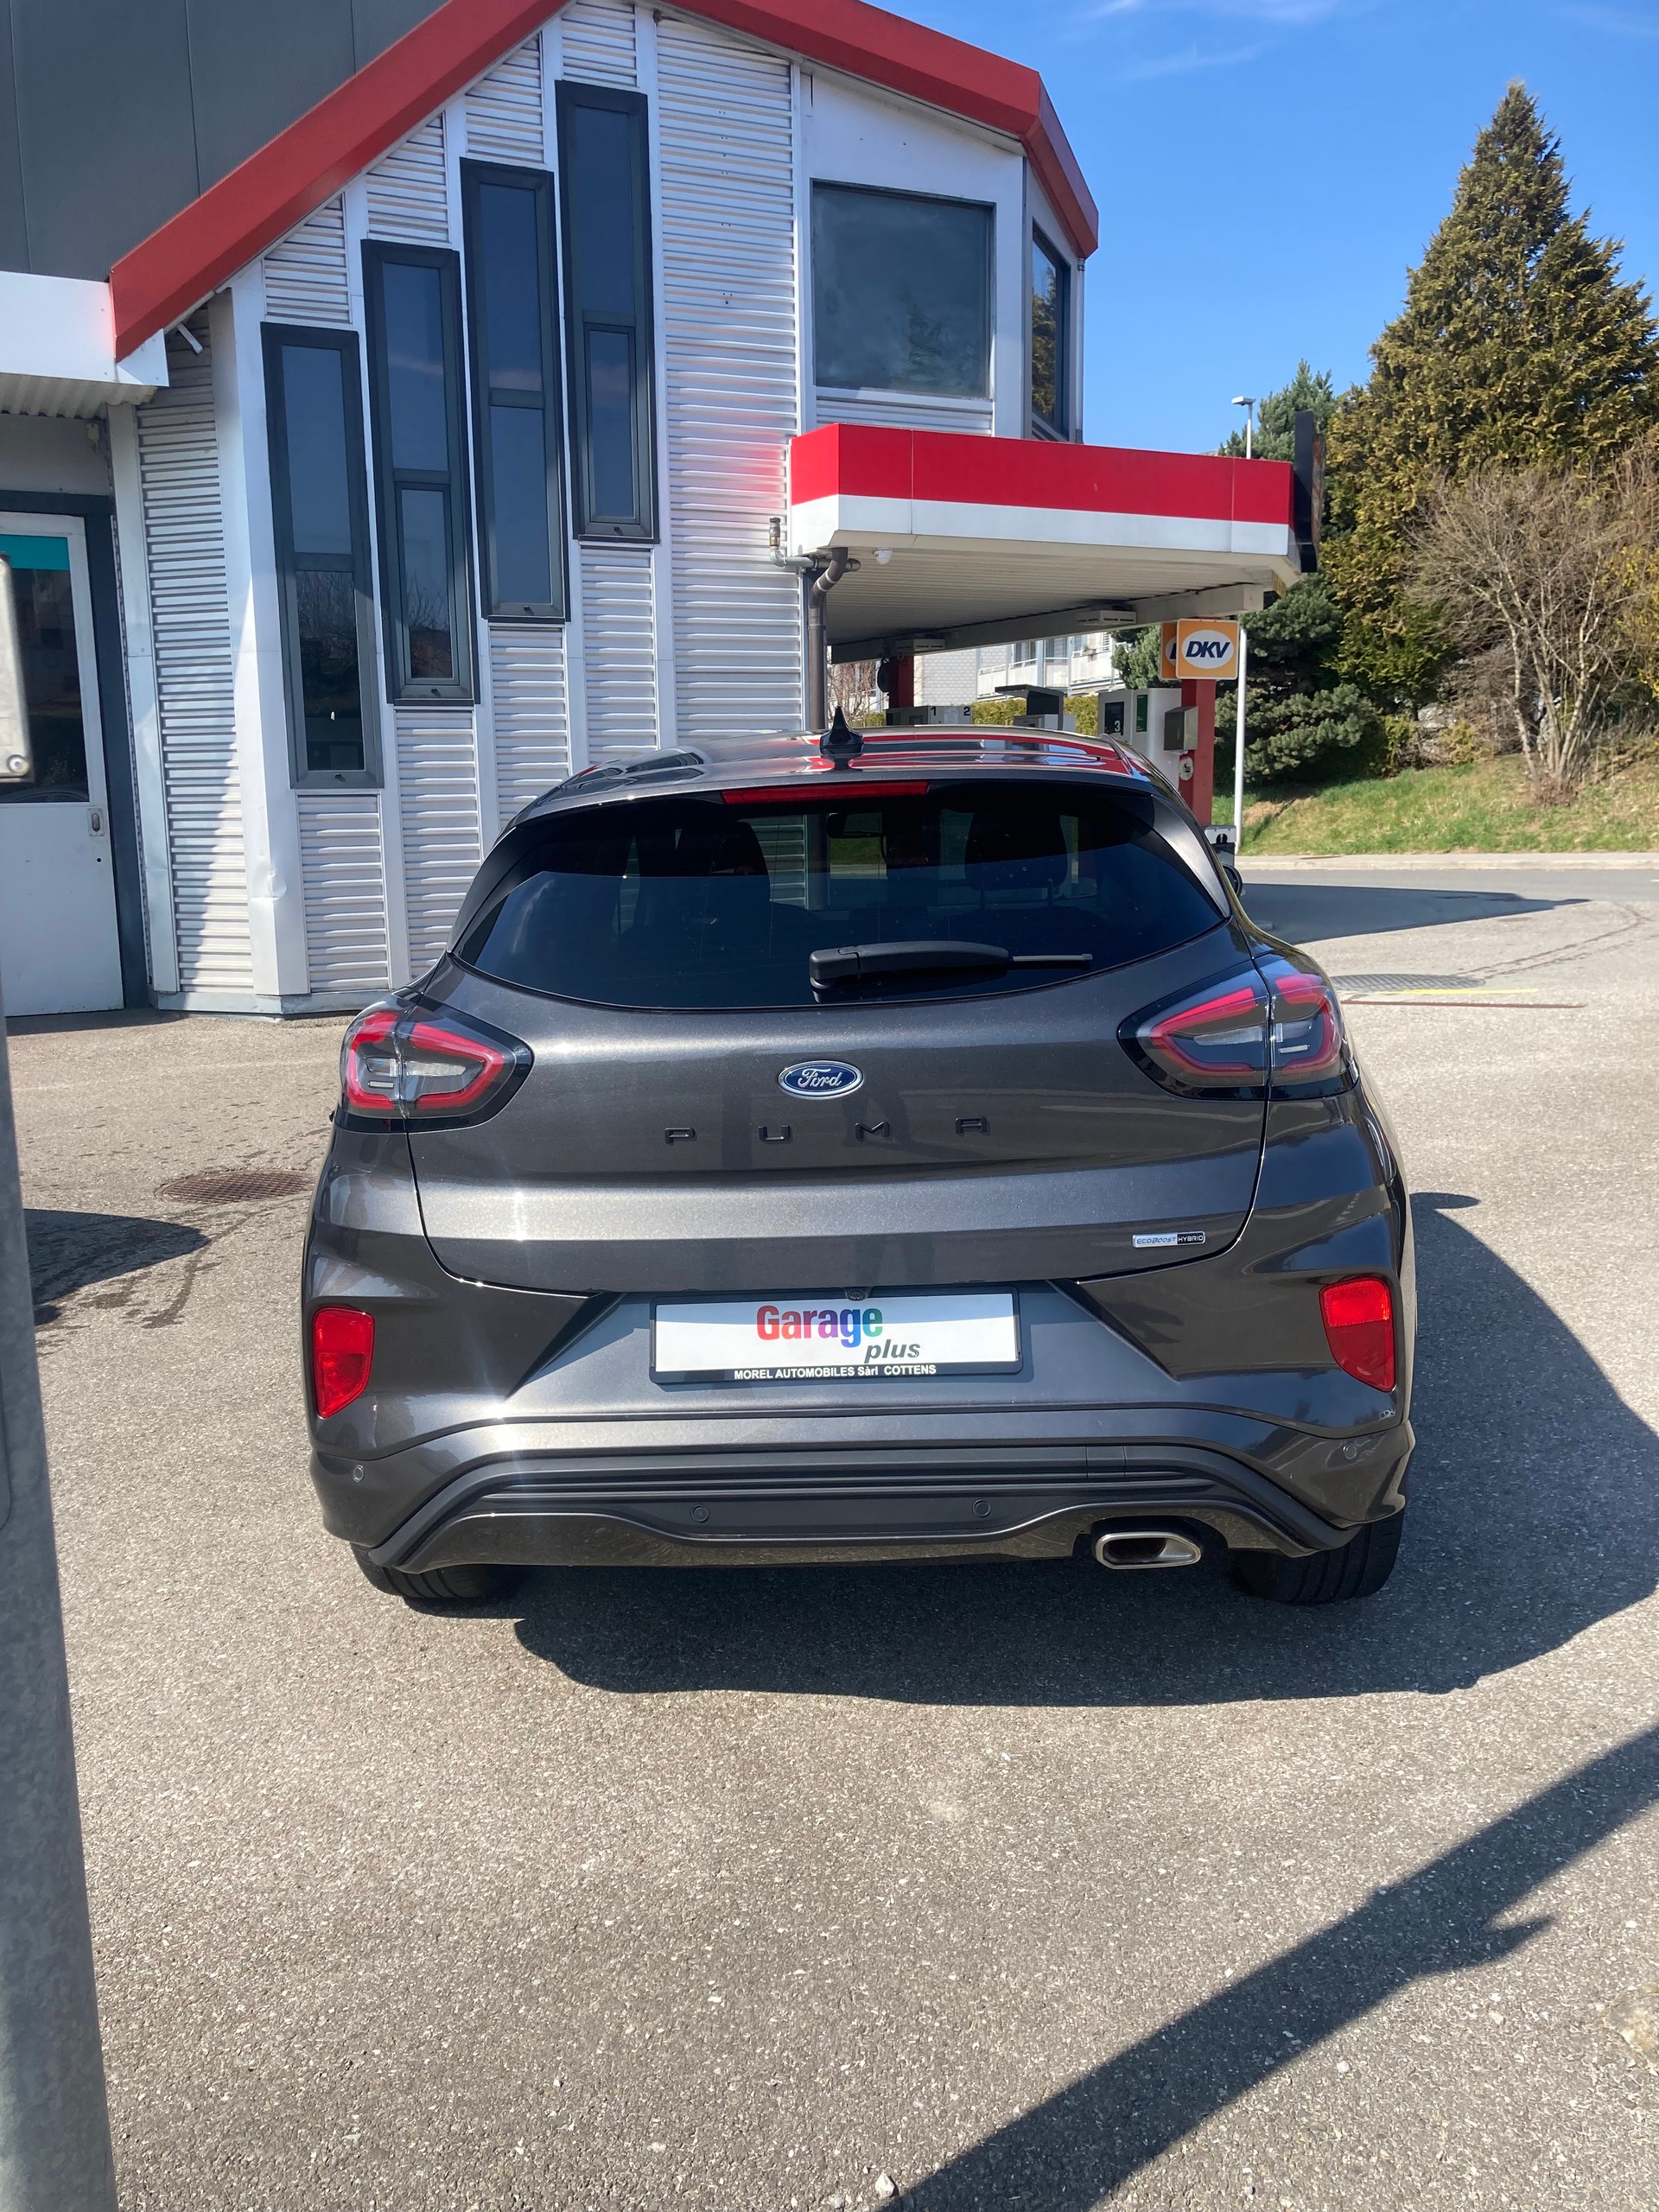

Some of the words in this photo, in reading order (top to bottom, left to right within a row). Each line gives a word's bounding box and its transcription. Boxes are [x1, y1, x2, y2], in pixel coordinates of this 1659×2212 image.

[1185, 641, 1230, 658] DKV
[931, 706, 937, 716] 1
[963, 706, 970, 716] 2
[1114, 720, 1121, 732] 3
[797, 1068, 842, 1088] Ford
[664, 1116, 988, 1145] PUMA
[756, 1305, 883, 1349] Garage
[864, 1339, 921, 1363] plus
[734, 1368, 773, 1380] MOREL
[775, 1366, 855, 1379] AUTOMOBILES
[857, 1365, 879, 1376] Sàrl
[883, 1363, 937, 1376] COTTENS
